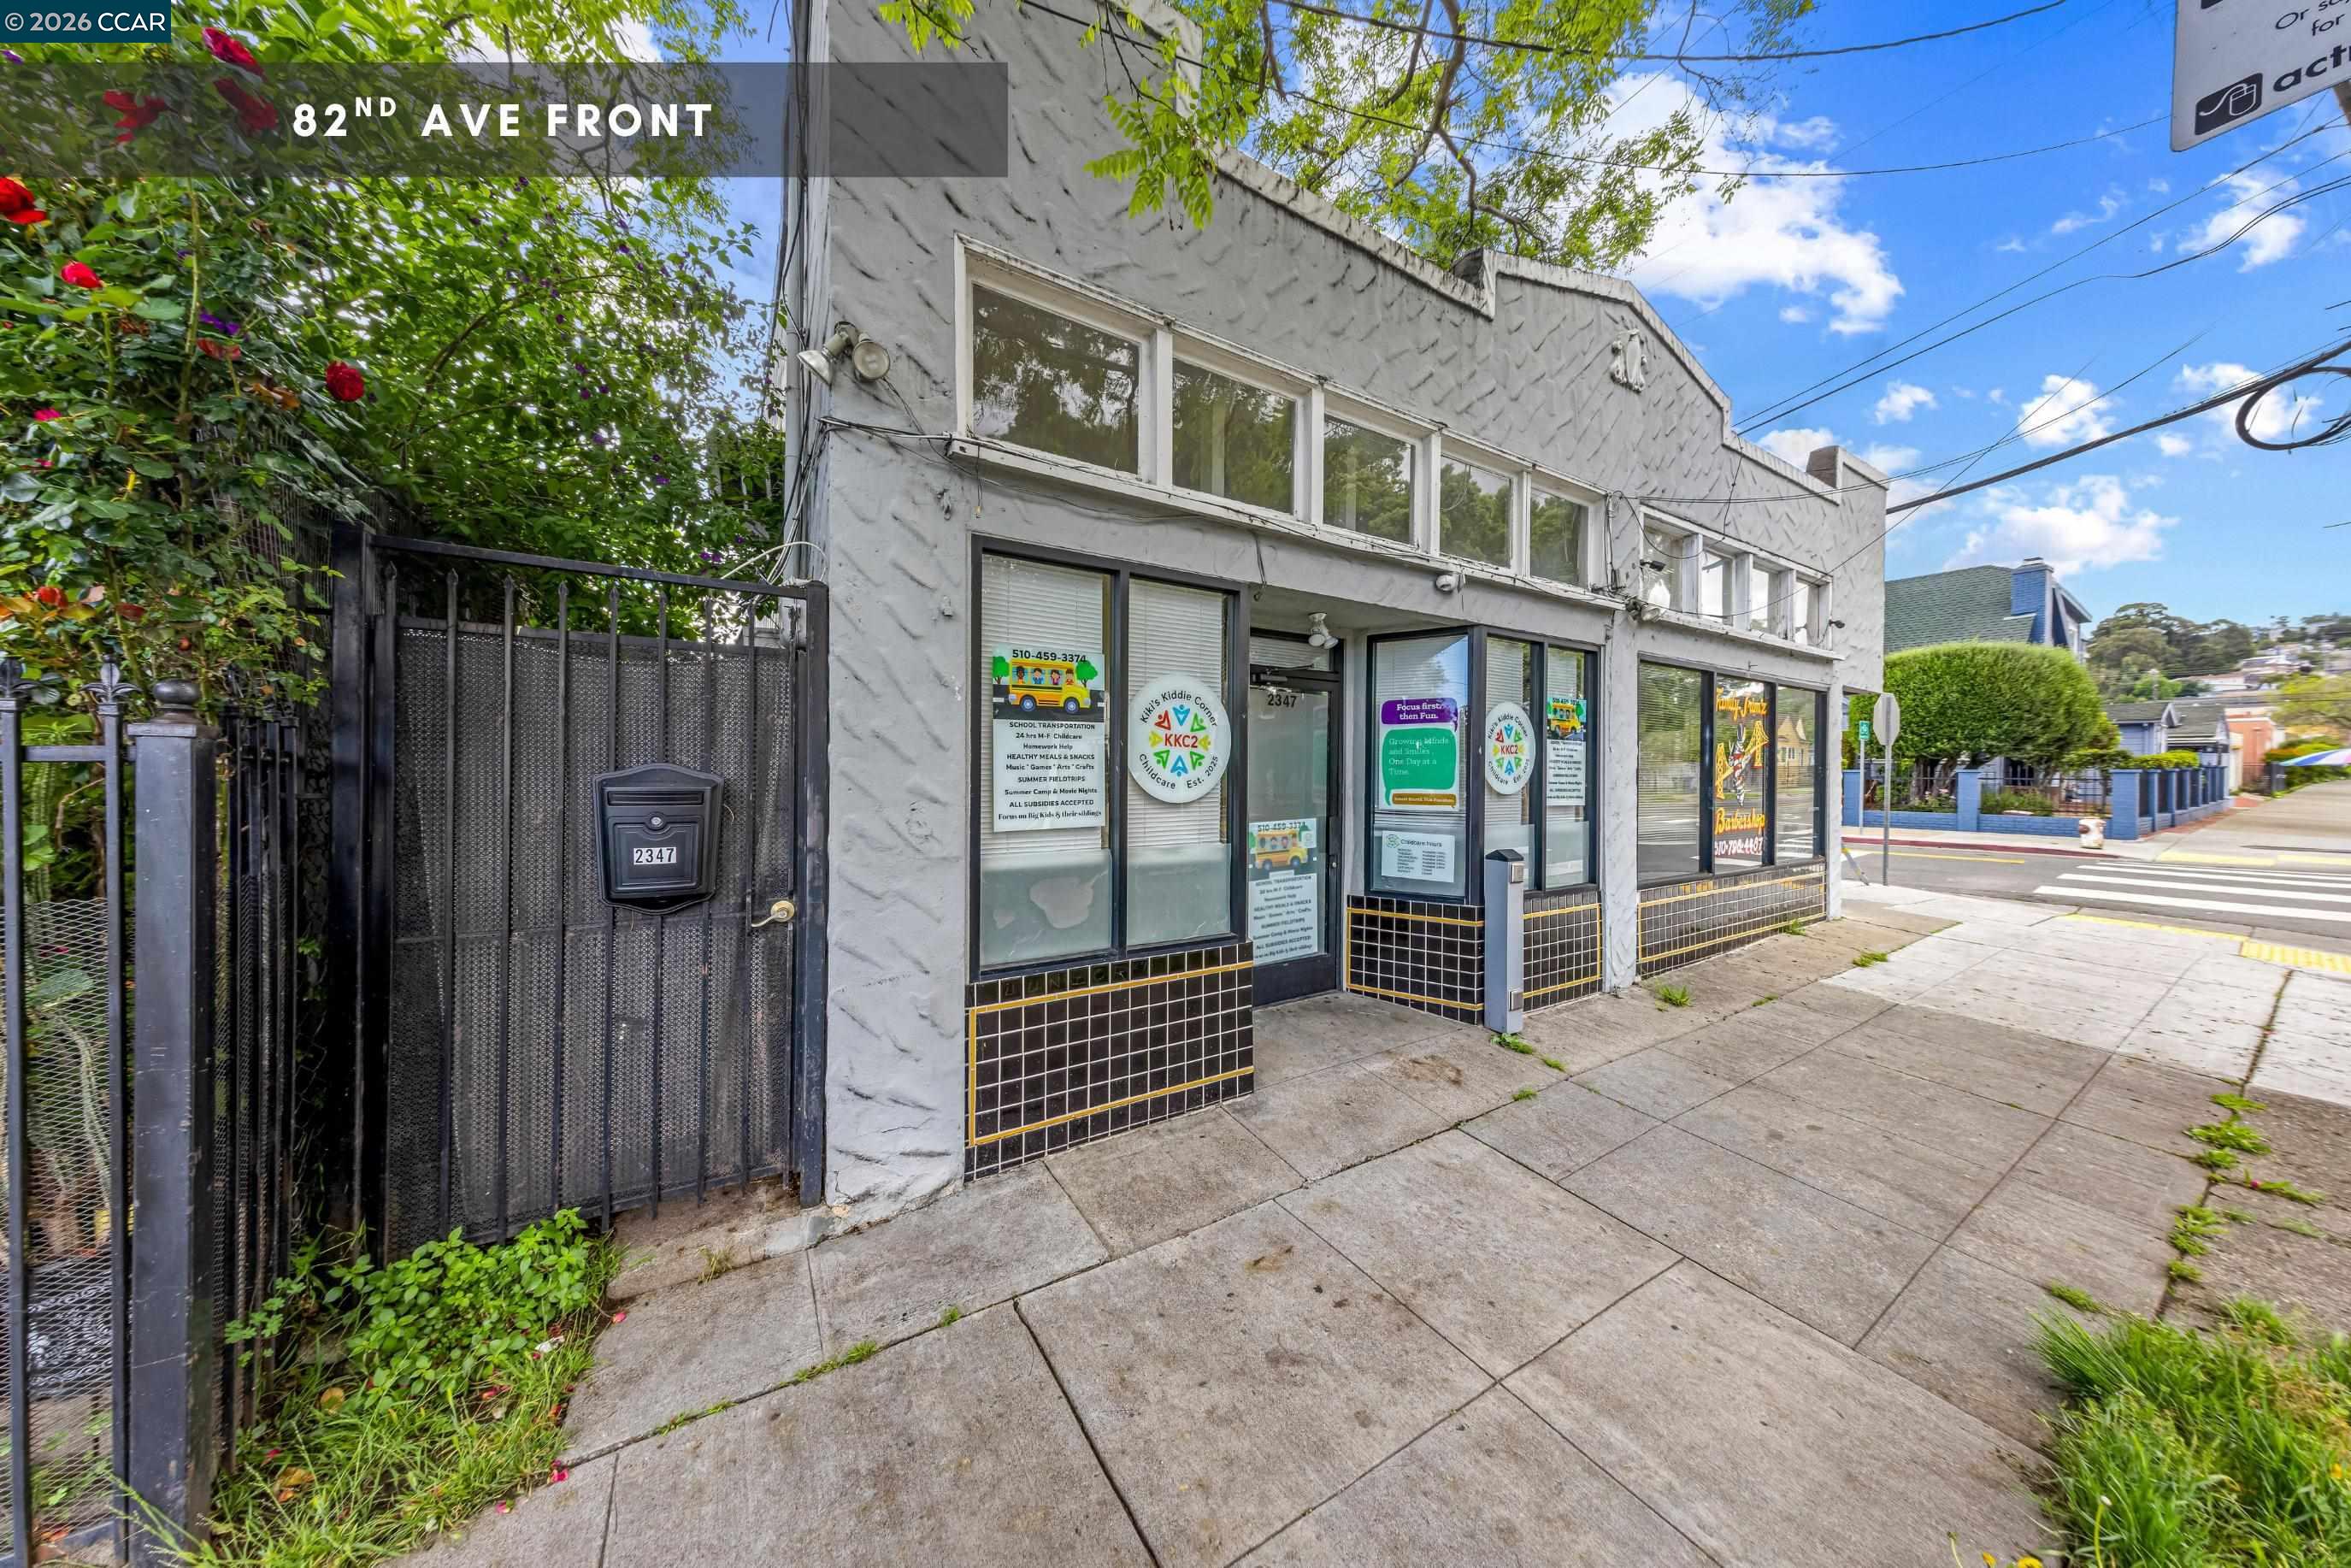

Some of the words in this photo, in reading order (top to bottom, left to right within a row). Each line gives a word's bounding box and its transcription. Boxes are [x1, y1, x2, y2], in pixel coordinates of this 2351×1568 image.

[2275, 9, 2310, 29] Or
[2312, 14, 2346, 36] for
[2273, 44, 2351, 91] act
[1012, 649, 1087, 663] 510-459-3374
[1140, 699, 1161, 723] Kiki's
[1161, 690, 1192, 702] Kiddie
[1194, 696, 1218, 727] Corner
[1268, 693, 1297, 708] 2347
[1164, 734, 1199, 748] KKC2
[1501, 745, 1518, 754] KKC2
[1139, 753, 1176, 790] Childcare
[1187, 778, 1205, 788] Est.
[1205, 756, 1218, 777] 2025
[1714, 807, 1765, 834] Barbershop
[635, 848, 675, 864] 2347
